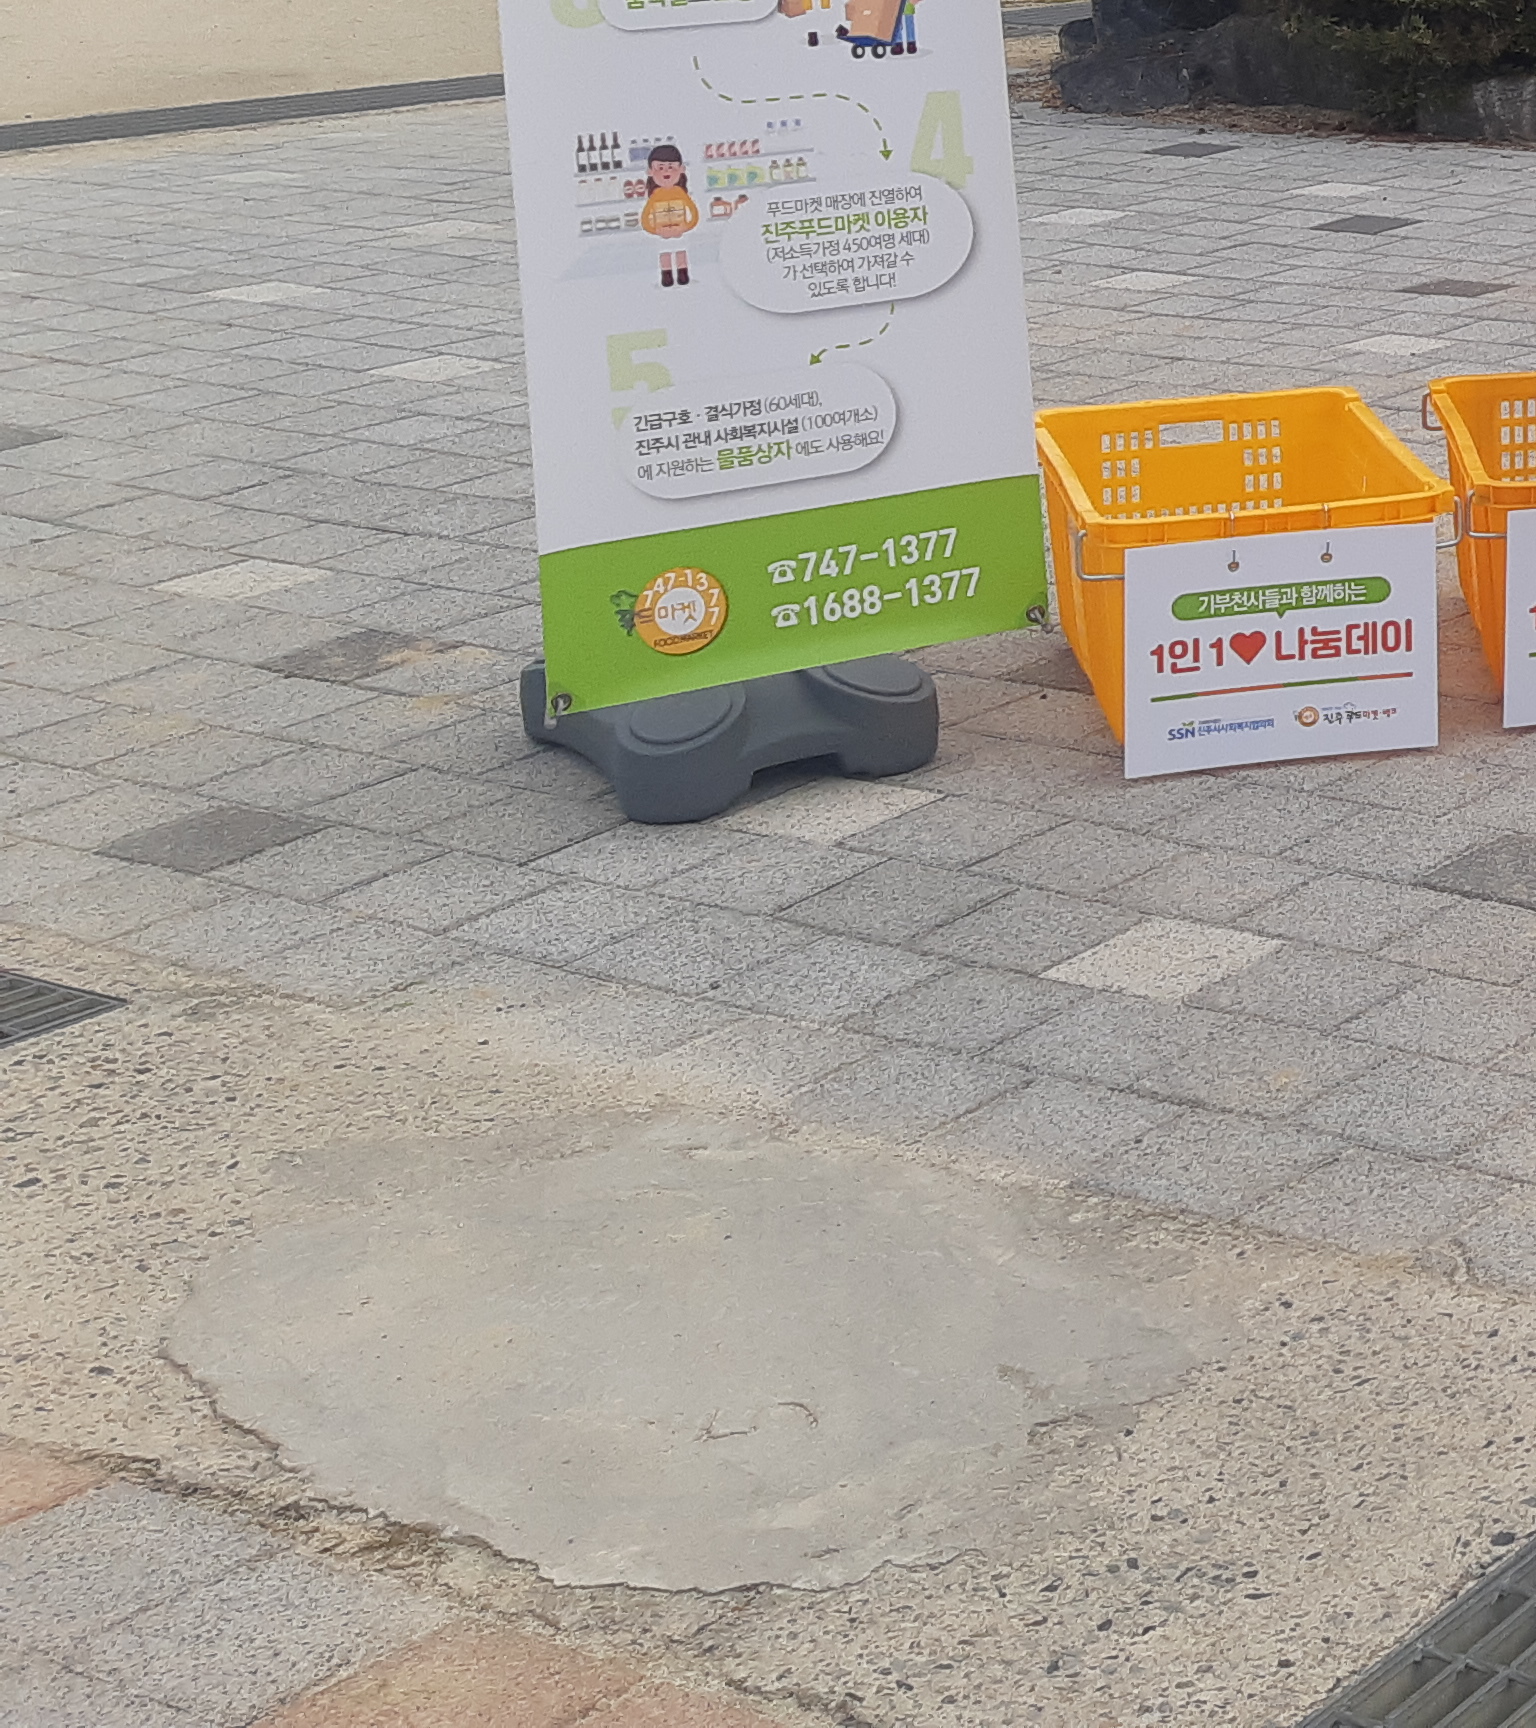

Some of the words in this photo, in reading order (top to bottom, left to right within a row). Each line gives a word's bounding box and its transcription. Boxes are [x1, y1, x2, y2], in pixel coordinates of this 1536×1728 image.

[911, 91, 973, 189] 4
[767, 196, 822, 217] 푸드마켓
[825, 192, 865, 210] 매장에
[869, 185, 922, 206] 진열하여
[762, 211, 871, 244] 진주푸드마켓
[875, 205, 928, 228] 이용자
[766, 241, 840, 263] (저소득가정
[843, 234, 895, 253] 450여명
[899, 229, 930, 247] 세대)
[783, 264, 798, 281] 가
[802, 258, 854, 279] 선택하여
[858, 253, 898, 271] 가져갈
[900, 251, 914, 266] 수
[808, 278, 849, 298] 있도록
[853, 274, 897, 293] 합니다!
[634, 409, 692, 432] 긴급구호
[705, 399, 762, 421] 결식가정
[636, 434, 680, 457] 진주시
[683, 428, 711, 449] 관내
[714, 418, 799, 443] 사회복지시설
[801, 405, 879, 431] (100여개소)
[637, 464, 653, 481] 에
[656, 455, 714, 478] 지원하는
[717, 440, 793, 470] 물품상자
[795, 438, 824, 457] 에도
[826, 429, 885, 453] 사용해요!
[799, 526, 958, 582] 747-1377
[802, 566, 981, 626] 1688-1377
[1198, 587, 1298, 615] 기부천사들과
[1300, 581, 1367, 606] 함께하는
[1149, 637, 1201, 674] 1인
[1274, 618, 1413, 661] 나눔데이
[1167, 726, 1196, 741] SSN
